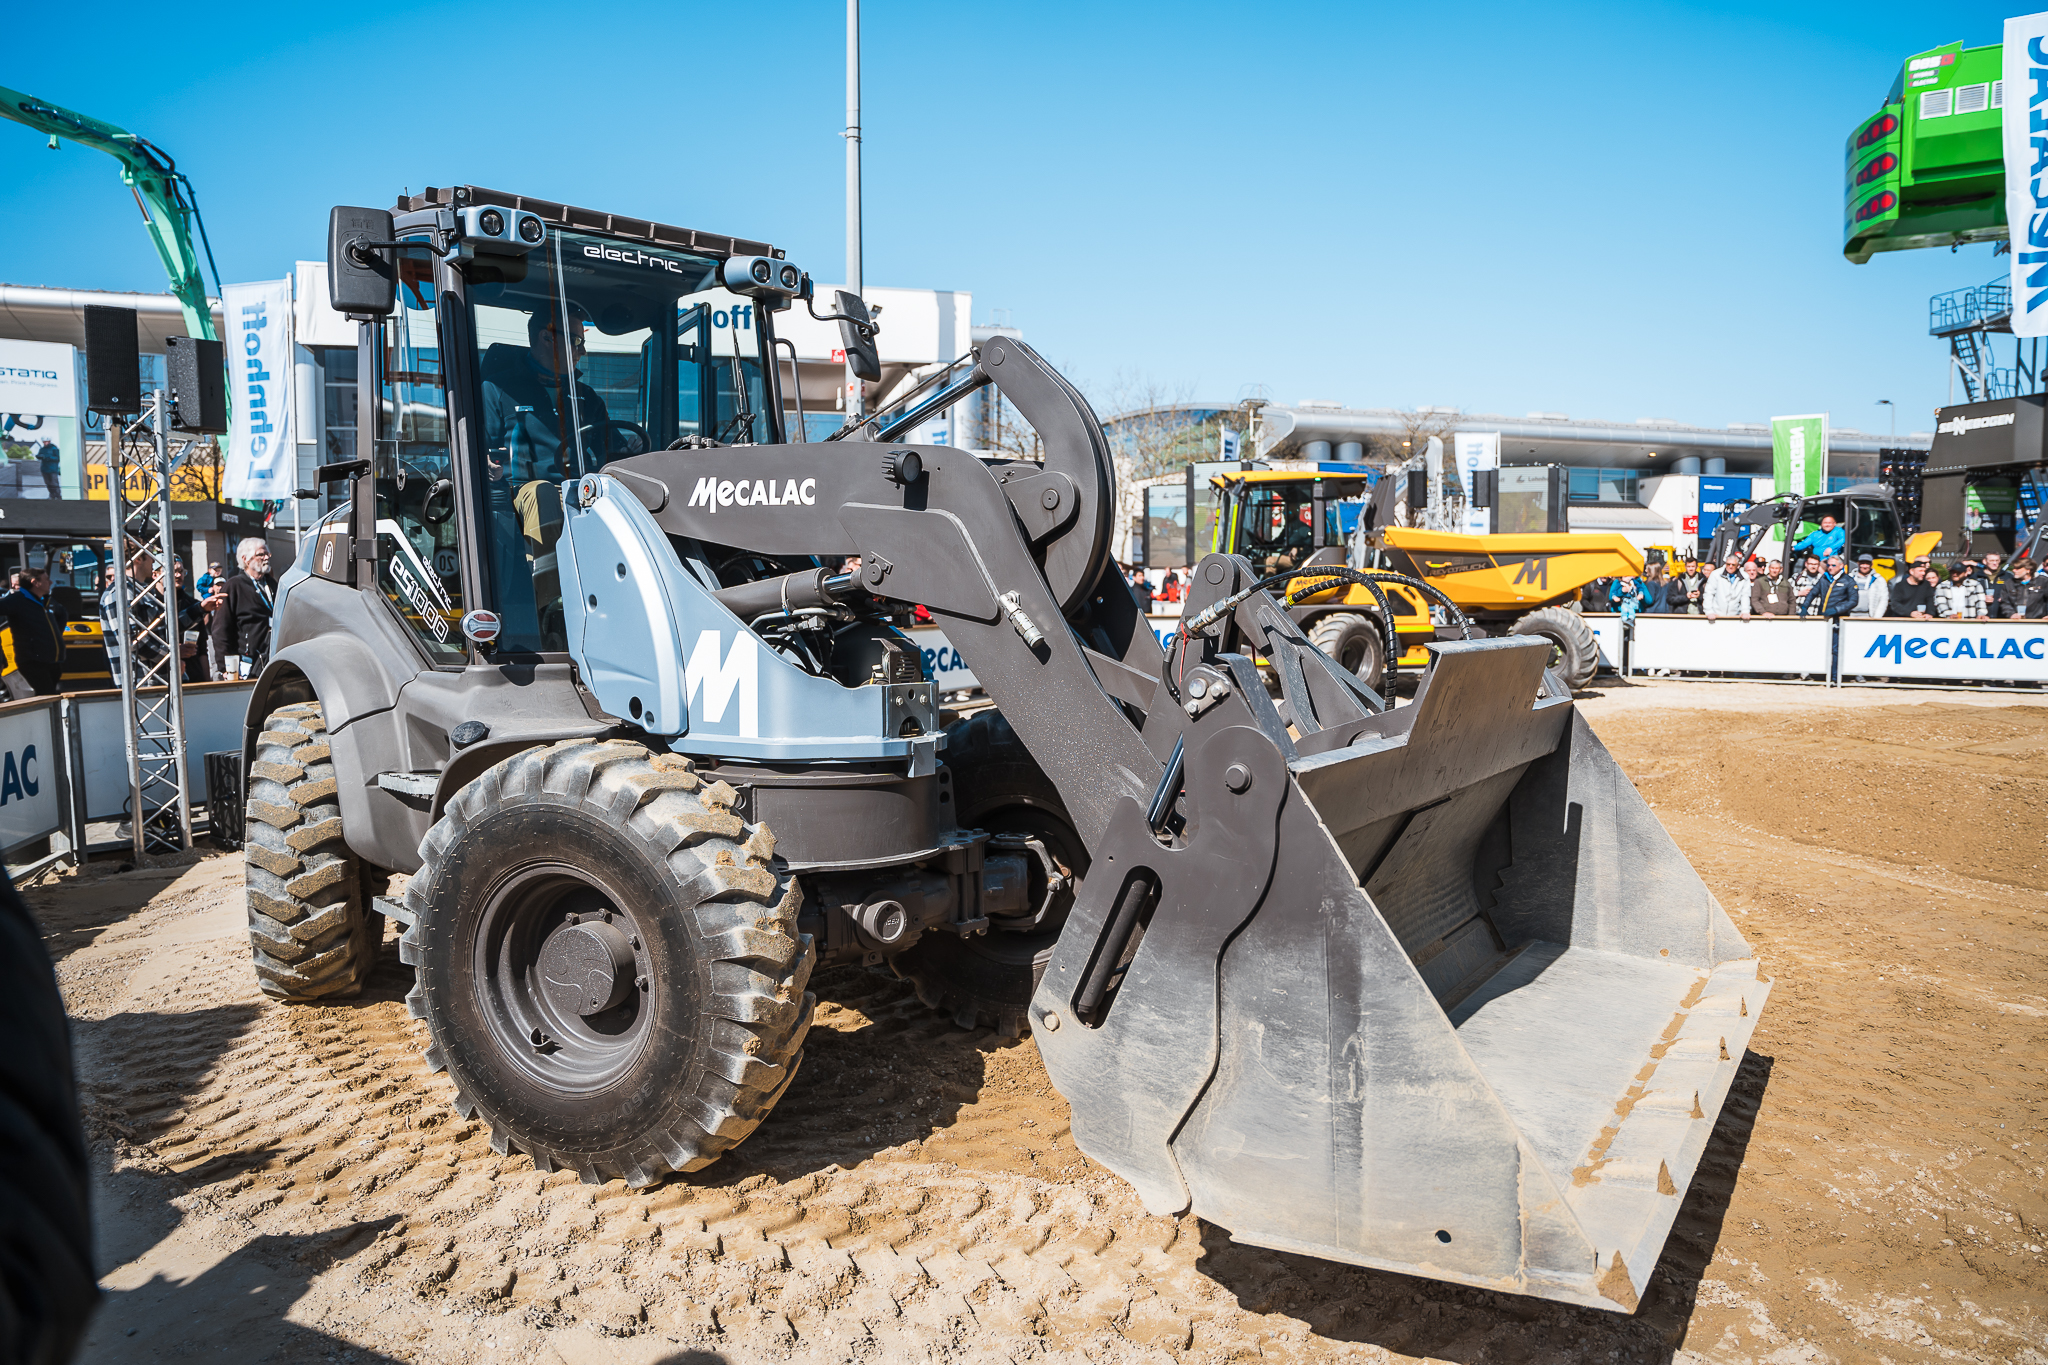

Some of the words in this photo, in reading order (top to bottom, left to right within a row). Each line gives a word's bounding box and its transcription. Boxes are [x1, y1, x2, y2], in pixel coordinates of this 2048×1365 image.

[583, 244, 683, 274] electric
[1512, 558, 1547, 590] M
[684, 629, 758, 738] M
